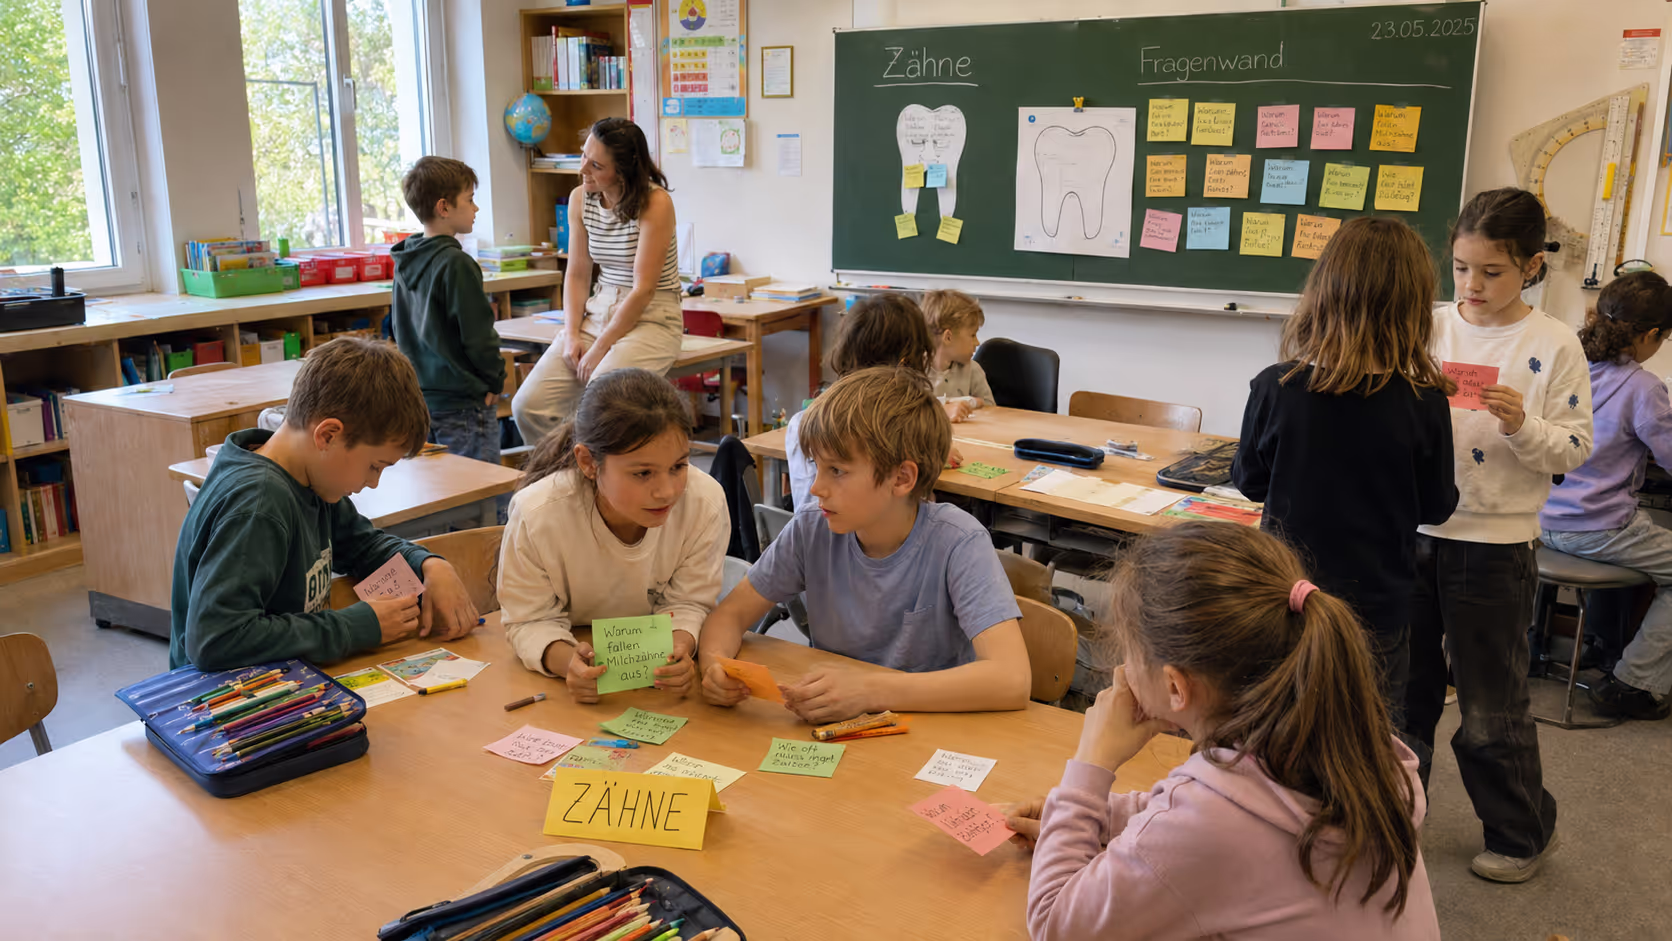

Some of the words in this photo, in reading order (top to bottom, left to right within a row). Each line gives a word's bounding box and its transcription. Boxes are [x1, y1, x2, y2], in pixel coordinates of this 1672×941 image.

[1371, 17, 1475, 39] 23.05.2025
[882, 46, 972, 78] Zähne
[1140, 41, 1284, 81] Fragenwand
[603, 625, 642, 638] Warum
[606, 641, 640, 653] fallen
[606, 651, 666, 667] Milchzähne
[620, 665, 649, 681] aus?
[778, 742, 797, 752] Wie
[801, 744, 818, 754] oft
[562, 779, 689, 832] ZÄHNE
